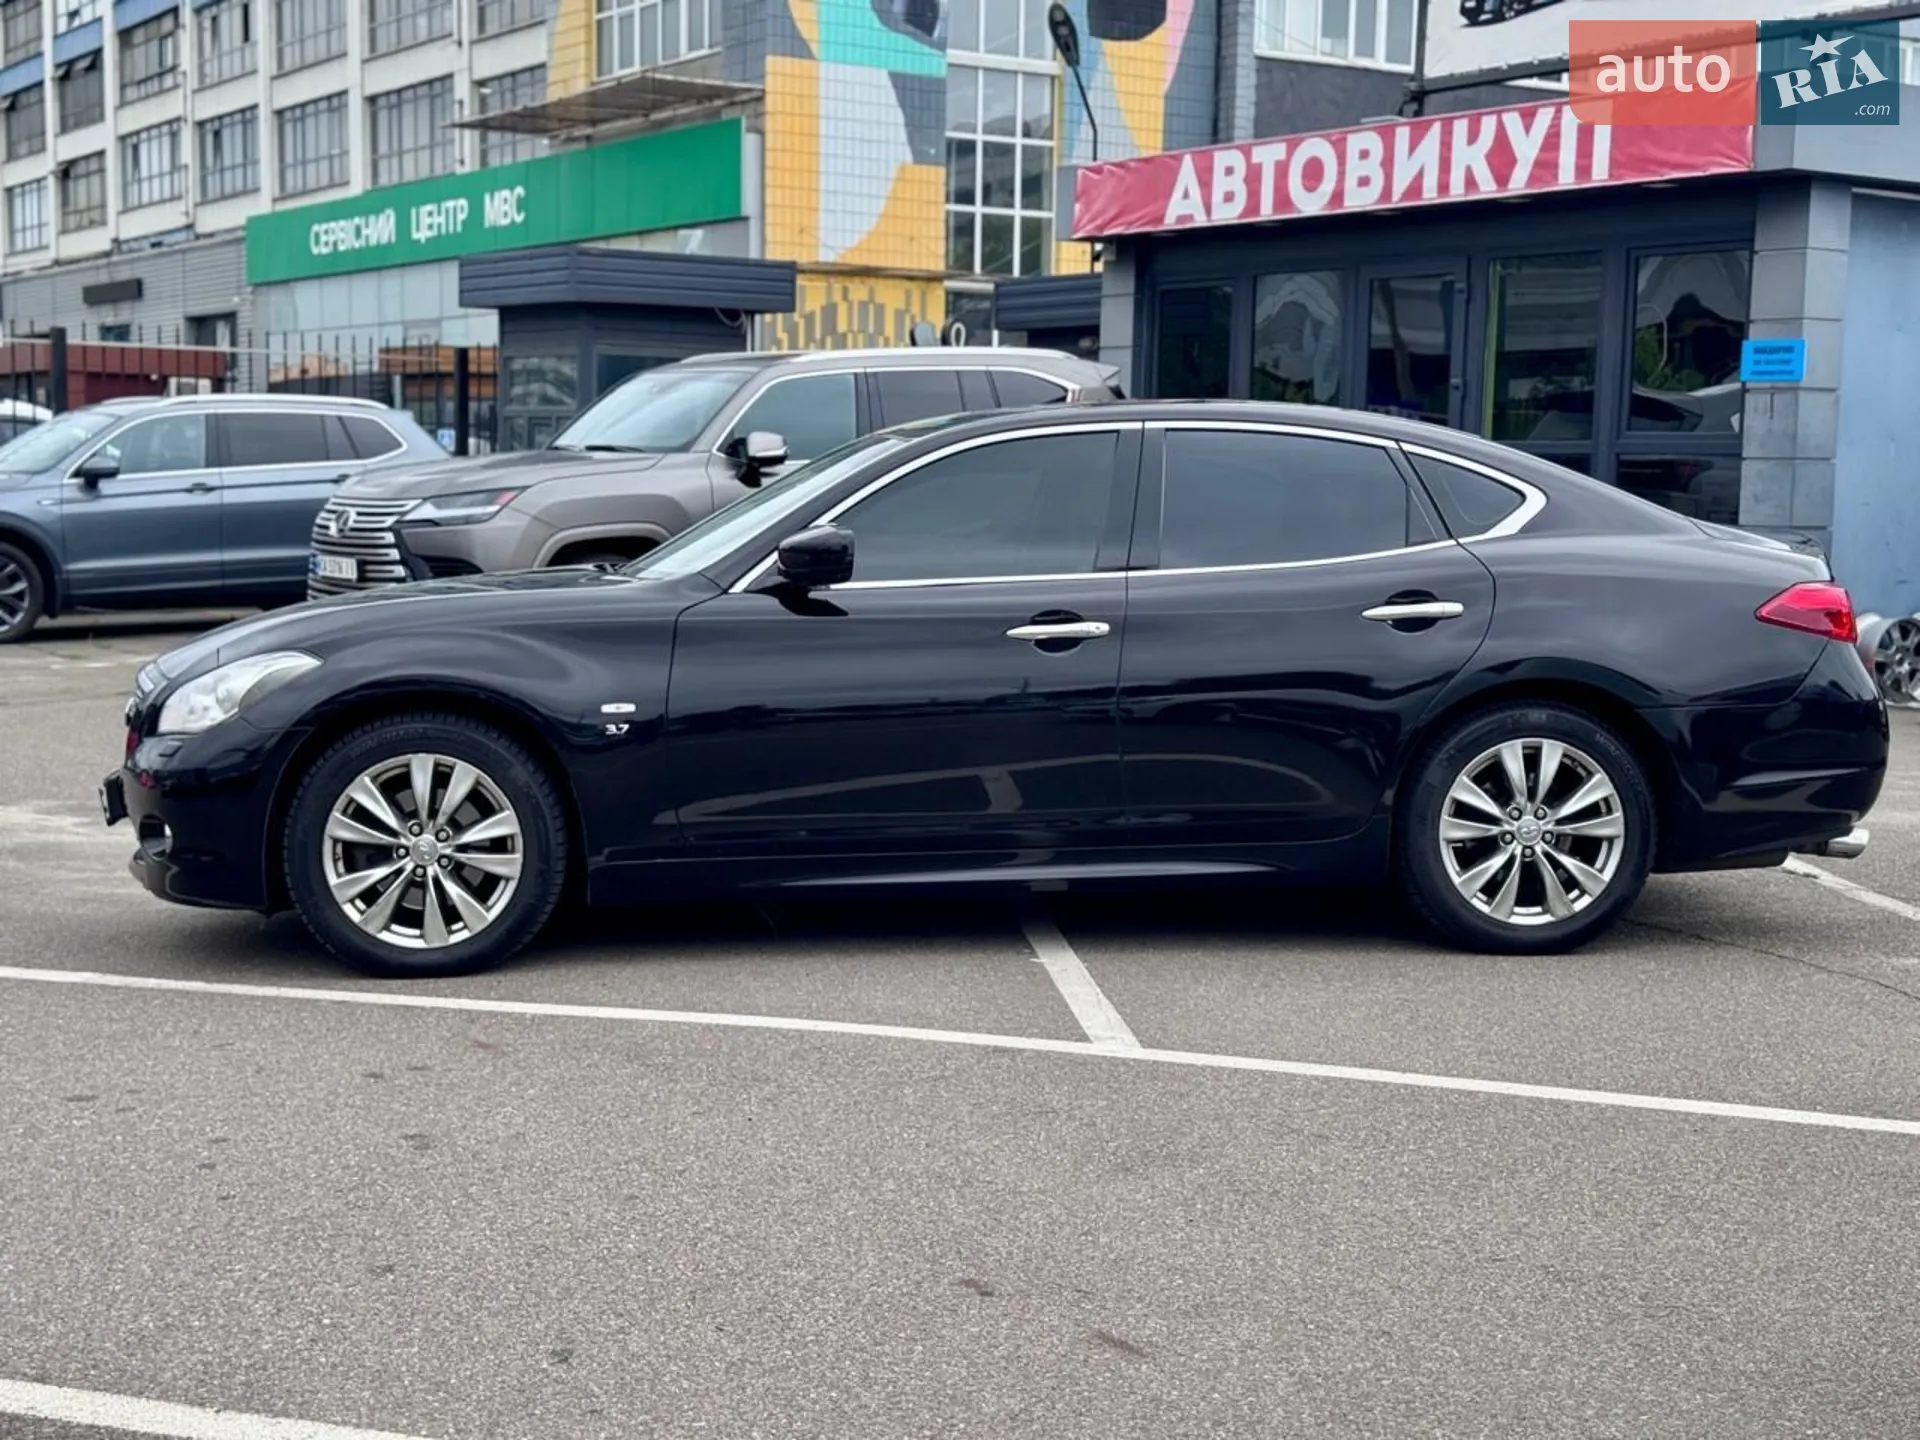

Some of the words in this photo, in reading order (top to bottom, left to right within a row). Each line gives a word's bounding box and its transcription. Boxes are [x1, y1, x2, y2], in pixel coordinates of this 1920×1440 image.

[1164, 105, 1612, 225] АВТОВИКУП
[310, 207, 396, 255] СЕРВІСНИЙ
[410, 198, 469, 243] ЦЕНТР
[484, 186, 526, 228] МВС
